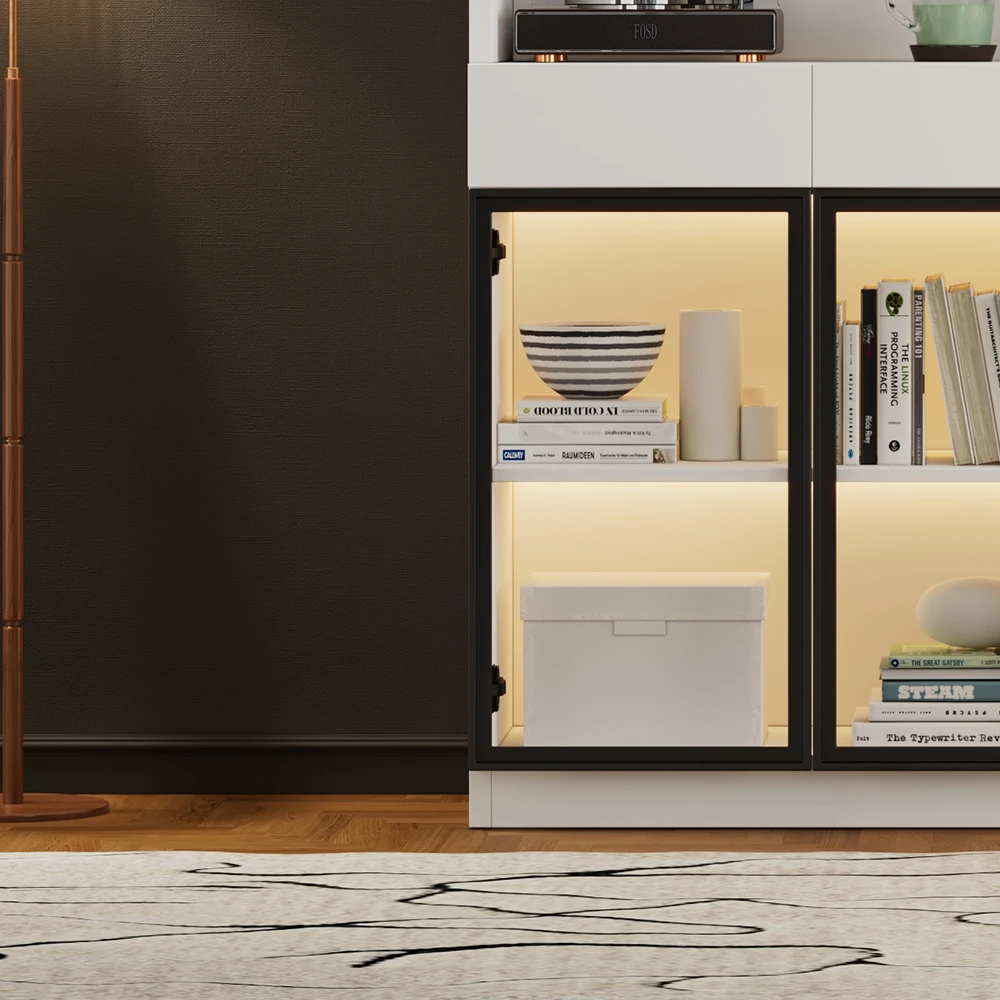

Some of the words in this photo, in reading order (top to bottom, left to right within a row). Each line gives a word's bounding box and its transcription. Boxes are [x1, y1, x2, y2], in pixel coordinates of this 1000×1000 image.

[634, 23, 658, 39] FOSD
[914, 294, 923, 346] PARENTING
[901, 343, 909, 362] THE
[914, 347, 923, 358] 101
[890, 331, 898, 407] PROGRAMMING
[901, 365, 909, 394] LINUX
[533, 406, 572, 416] BLOOD
[574, 406, 604, 416] COLD
[606, 406, 618, 416] IN
[562, 451, 595, 459] RAUMIDEEN
[911, 659, 921, 667] THE
[922, 659, 941, 667] GREAT
[942, 659, 964, 667] GATSBY
[897, 685, 974, 700] STEAM
[886, 733, 906, 742] The
[910, 733, 977, 744] Typewriter
